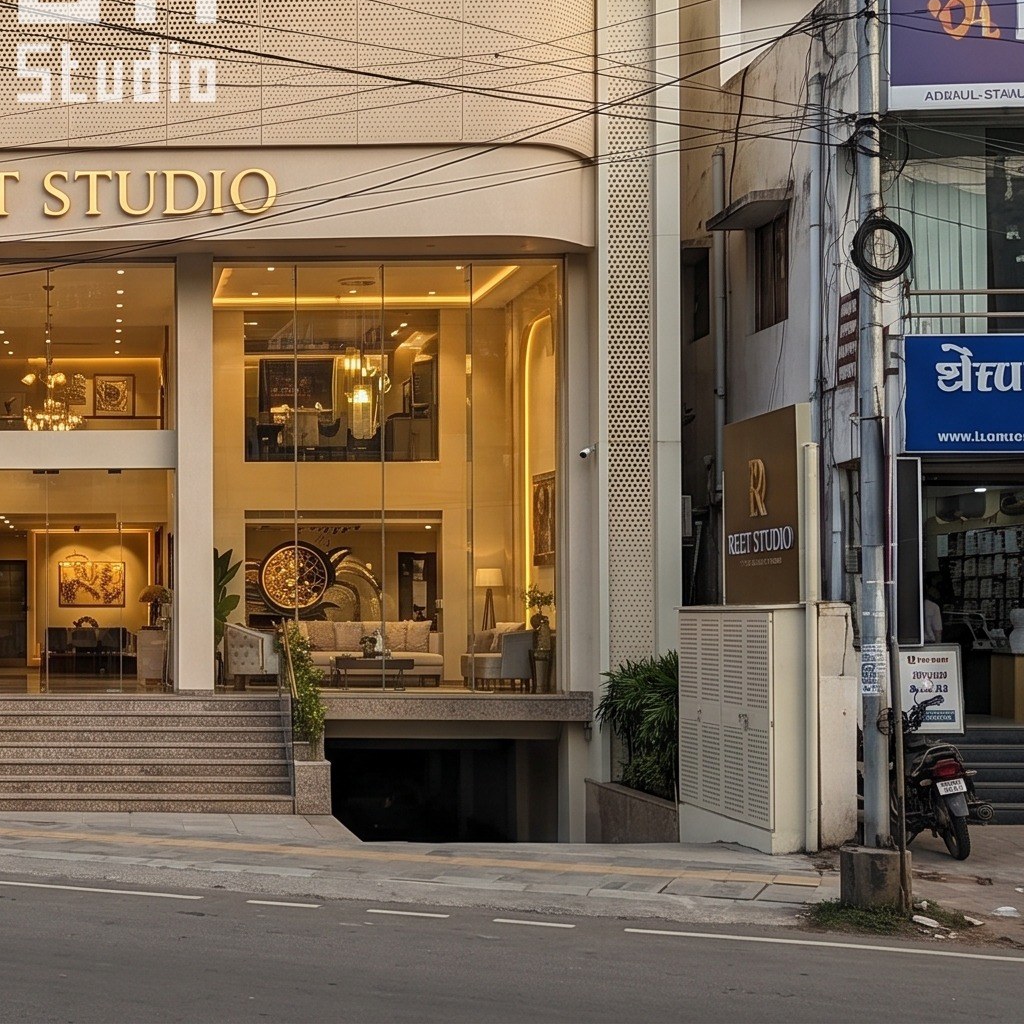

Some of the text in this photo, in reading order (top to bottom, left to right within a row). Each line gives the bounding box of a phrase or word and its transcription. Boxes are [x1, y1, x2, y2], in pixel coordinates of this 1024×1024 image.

[43, 168, 278, 217] STUDIO
[728, 525, 794, 555] REET STUDIO
